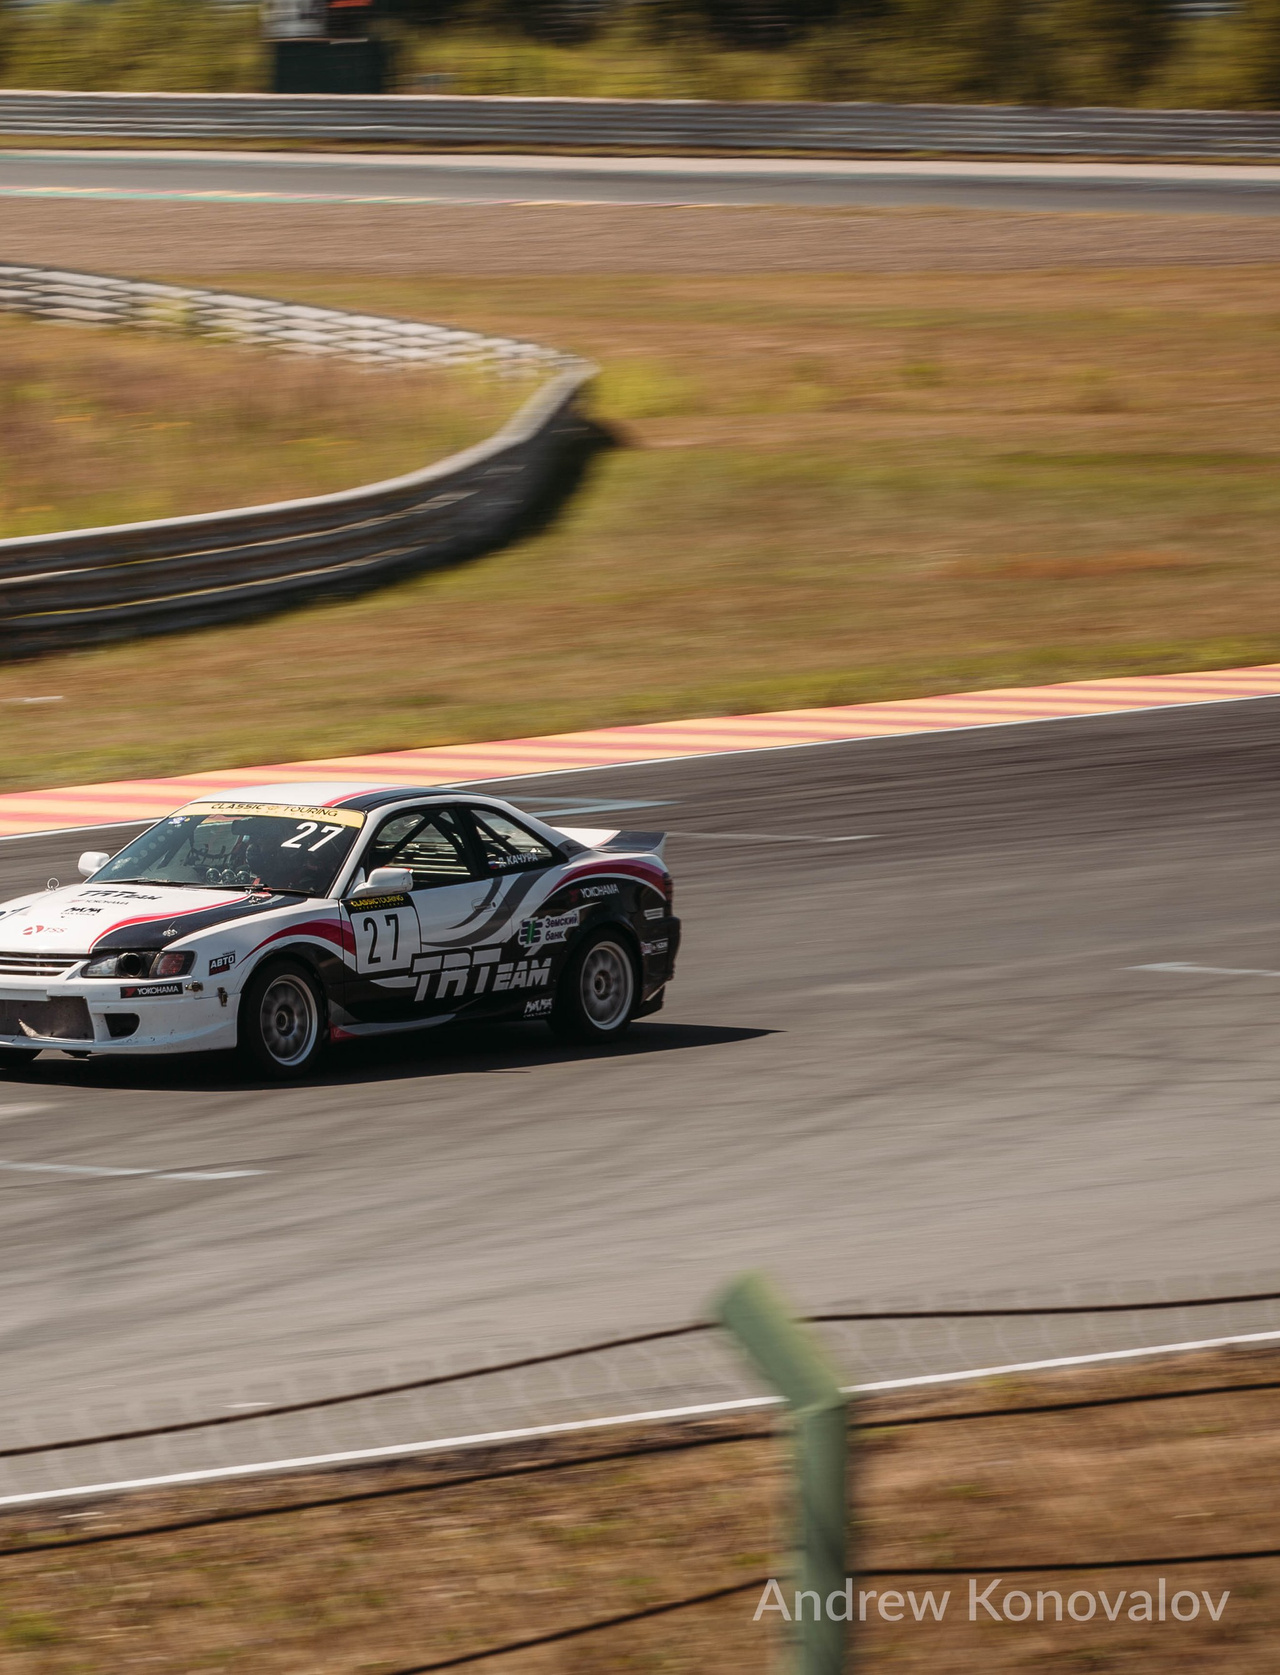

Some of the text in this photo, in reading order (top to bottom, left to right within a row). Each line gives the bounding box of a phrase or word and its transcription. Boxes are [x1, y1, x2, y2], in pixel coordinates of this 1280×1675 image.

[210, 803, 265, 811] CLASSIC
[282, 806, 339, 817] TOURING
[280, 821, 346, 852] 27
[506, 852, 539, 865] КАЧУРА
[580, 883, 620, 899] YOKOHAMA
[545, 913, 578, 928] Земский
[363, 913, 400, 965] 27
[545, 930, 564, 941] банк
[210, 955, 235, 969] АВТО
[136, 985, 180, 996] YOKOHAMA
